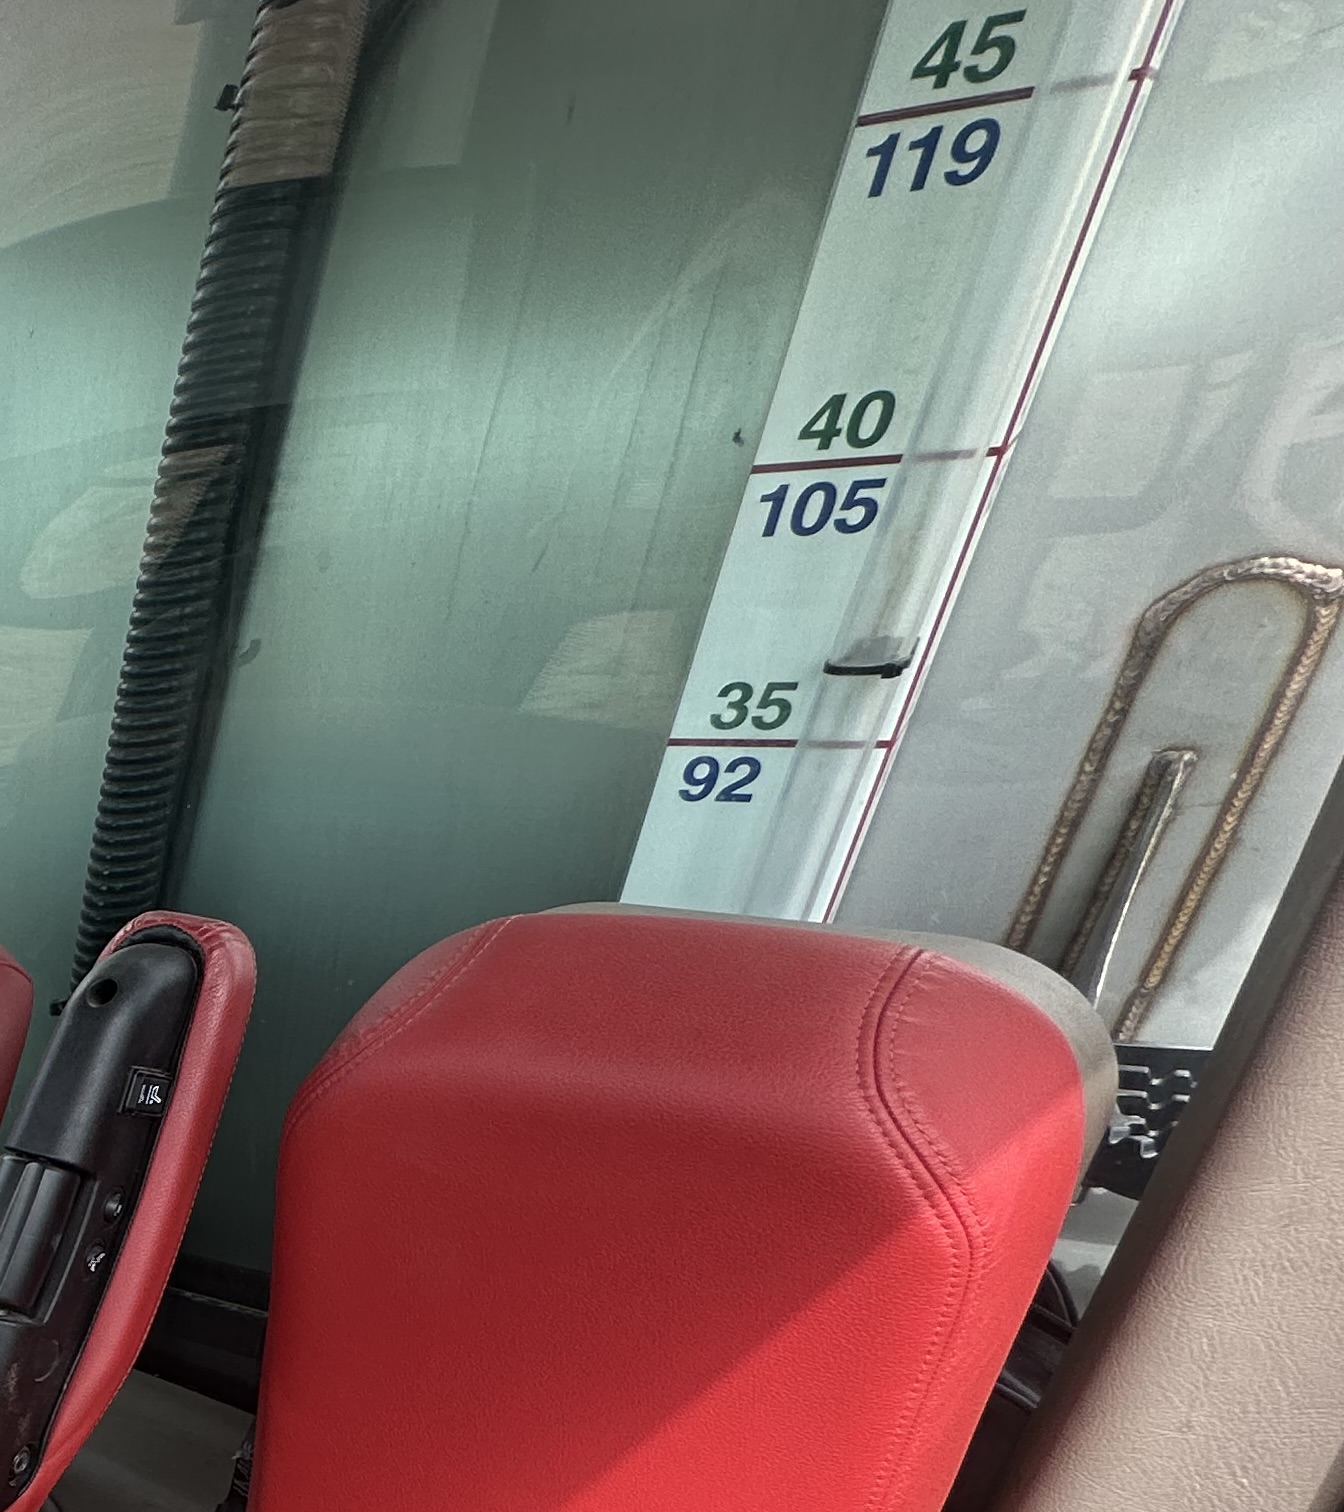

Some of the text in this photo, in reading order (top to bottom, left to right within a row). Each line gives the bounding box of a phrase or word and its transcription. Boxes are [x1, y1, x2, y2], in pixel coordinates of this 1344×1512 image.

[911, 9, 1028, 89] 45
[865, 118, 1001, 198] 119
[798, 390, 896, 451] 40
[759, 478, 888, 538] 105
[710, 681, 799, 731] 35
[678, 755, 762, 803] 92
